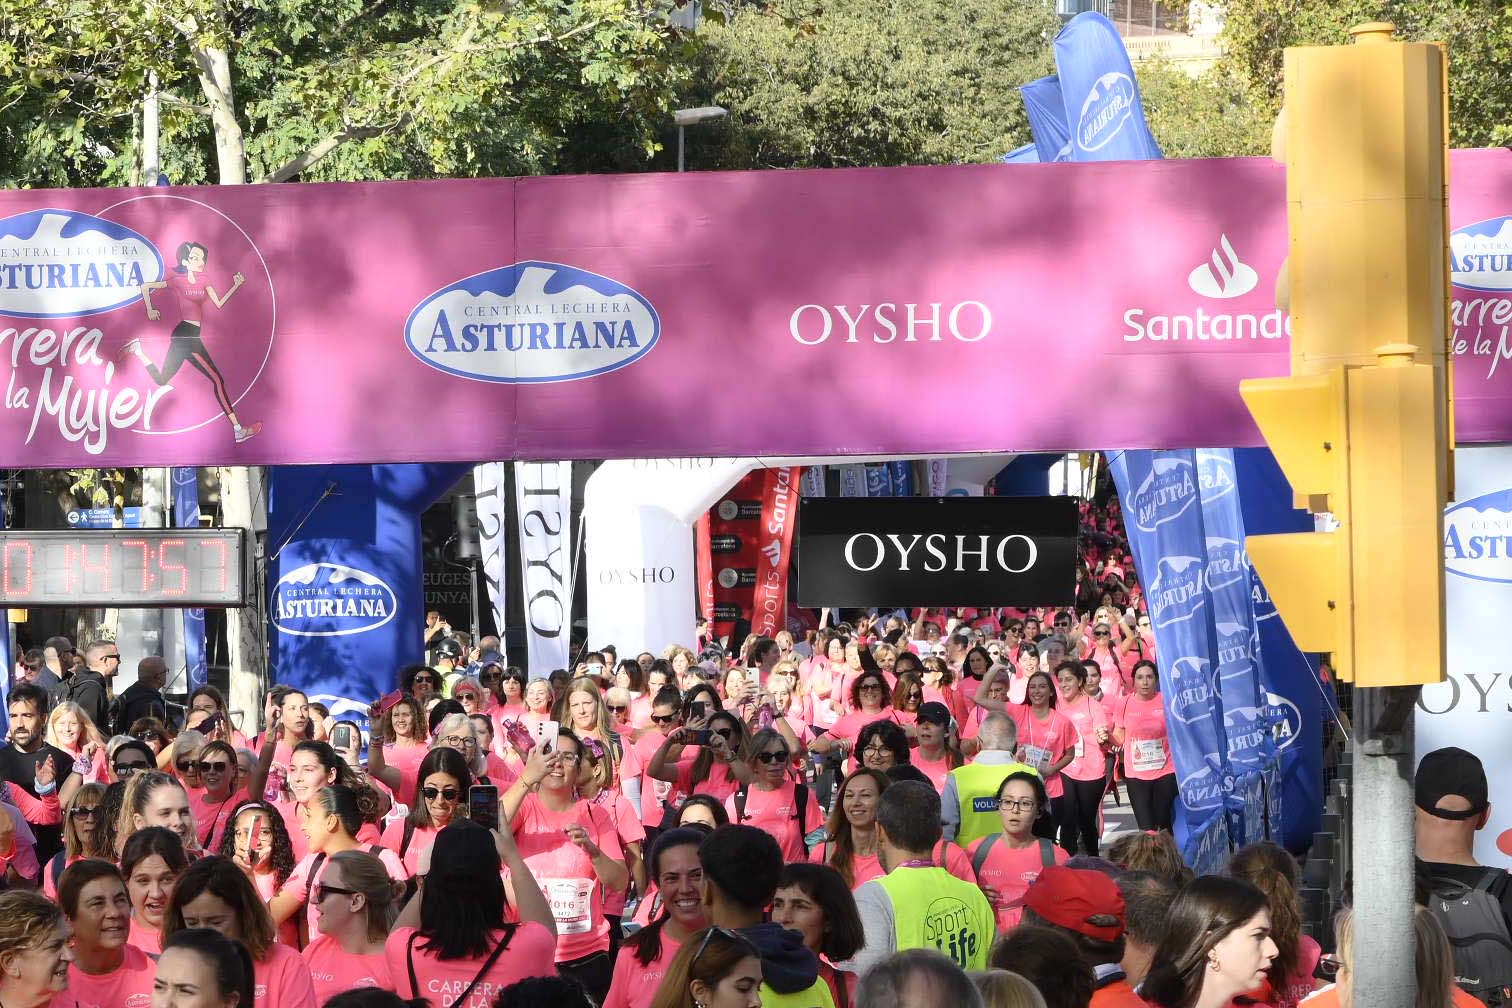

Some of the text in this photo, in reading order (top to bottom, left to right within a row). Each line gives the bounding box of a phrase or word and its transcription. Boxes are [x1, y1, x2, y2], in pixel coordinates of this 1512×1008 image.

[463, 302, 633, 317] CENTRAL LECHERA
[789, 300, 992, 346] OYSHO
[1122, 307, 1292, 342] Santand
[424, 308, 641, 353] ASTURIANA
[4, 368, 30, 410] la
[24, 364, 175, 455] Mujer
[767, 466, 792, 537] Santa
[843, 532, 1039, 574] OYSHO
[286, 588, 329, 597] CENTRAL
[599, 566, 675, 585] OYSHO
[274, 592, 388, 620] ASTURIANA
[926, 904, 969, 942] Sport
